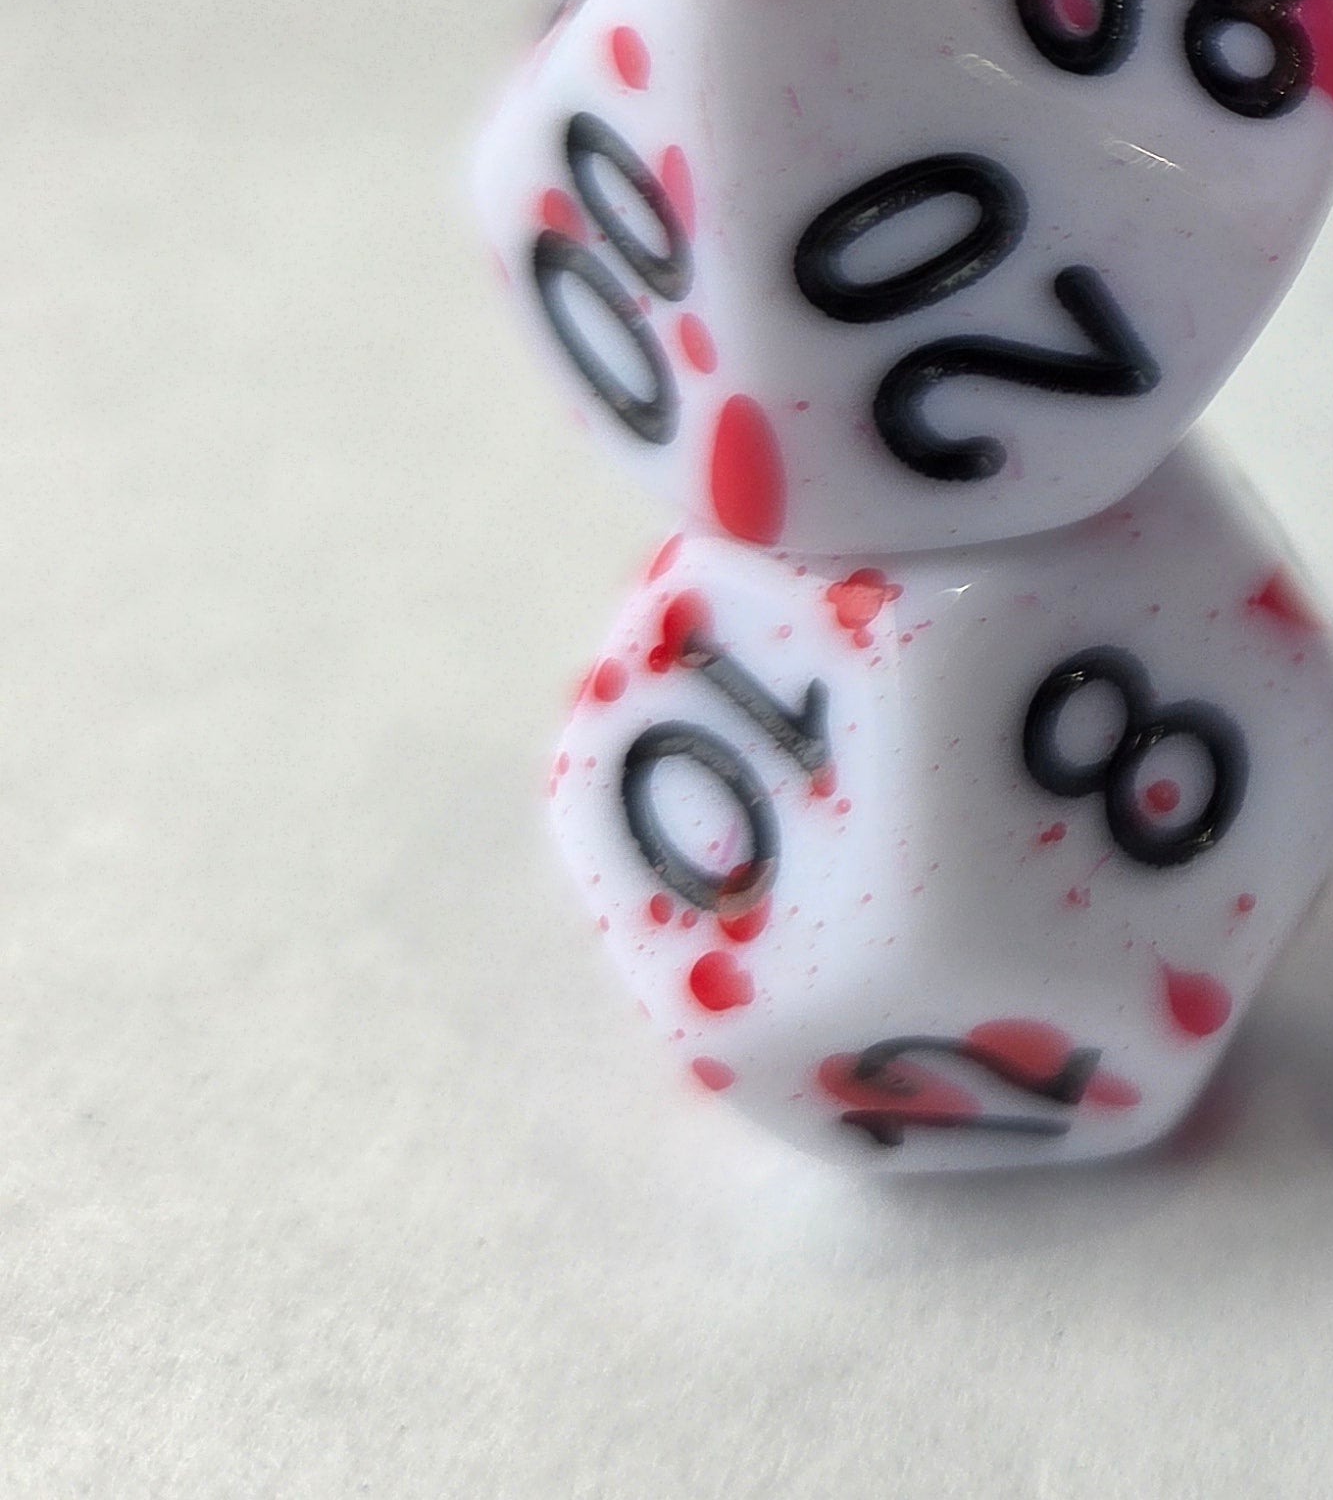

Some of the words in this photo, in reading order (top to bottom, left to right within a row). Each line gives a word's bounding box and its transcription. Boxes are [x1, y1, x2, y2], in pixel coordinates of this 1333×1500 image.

[532, 112, 696, 444] 00
[794, 152, 1162, 482] 20
[620, 630, 832, 914] 10
[1022, 644, 1250, 870] 8
